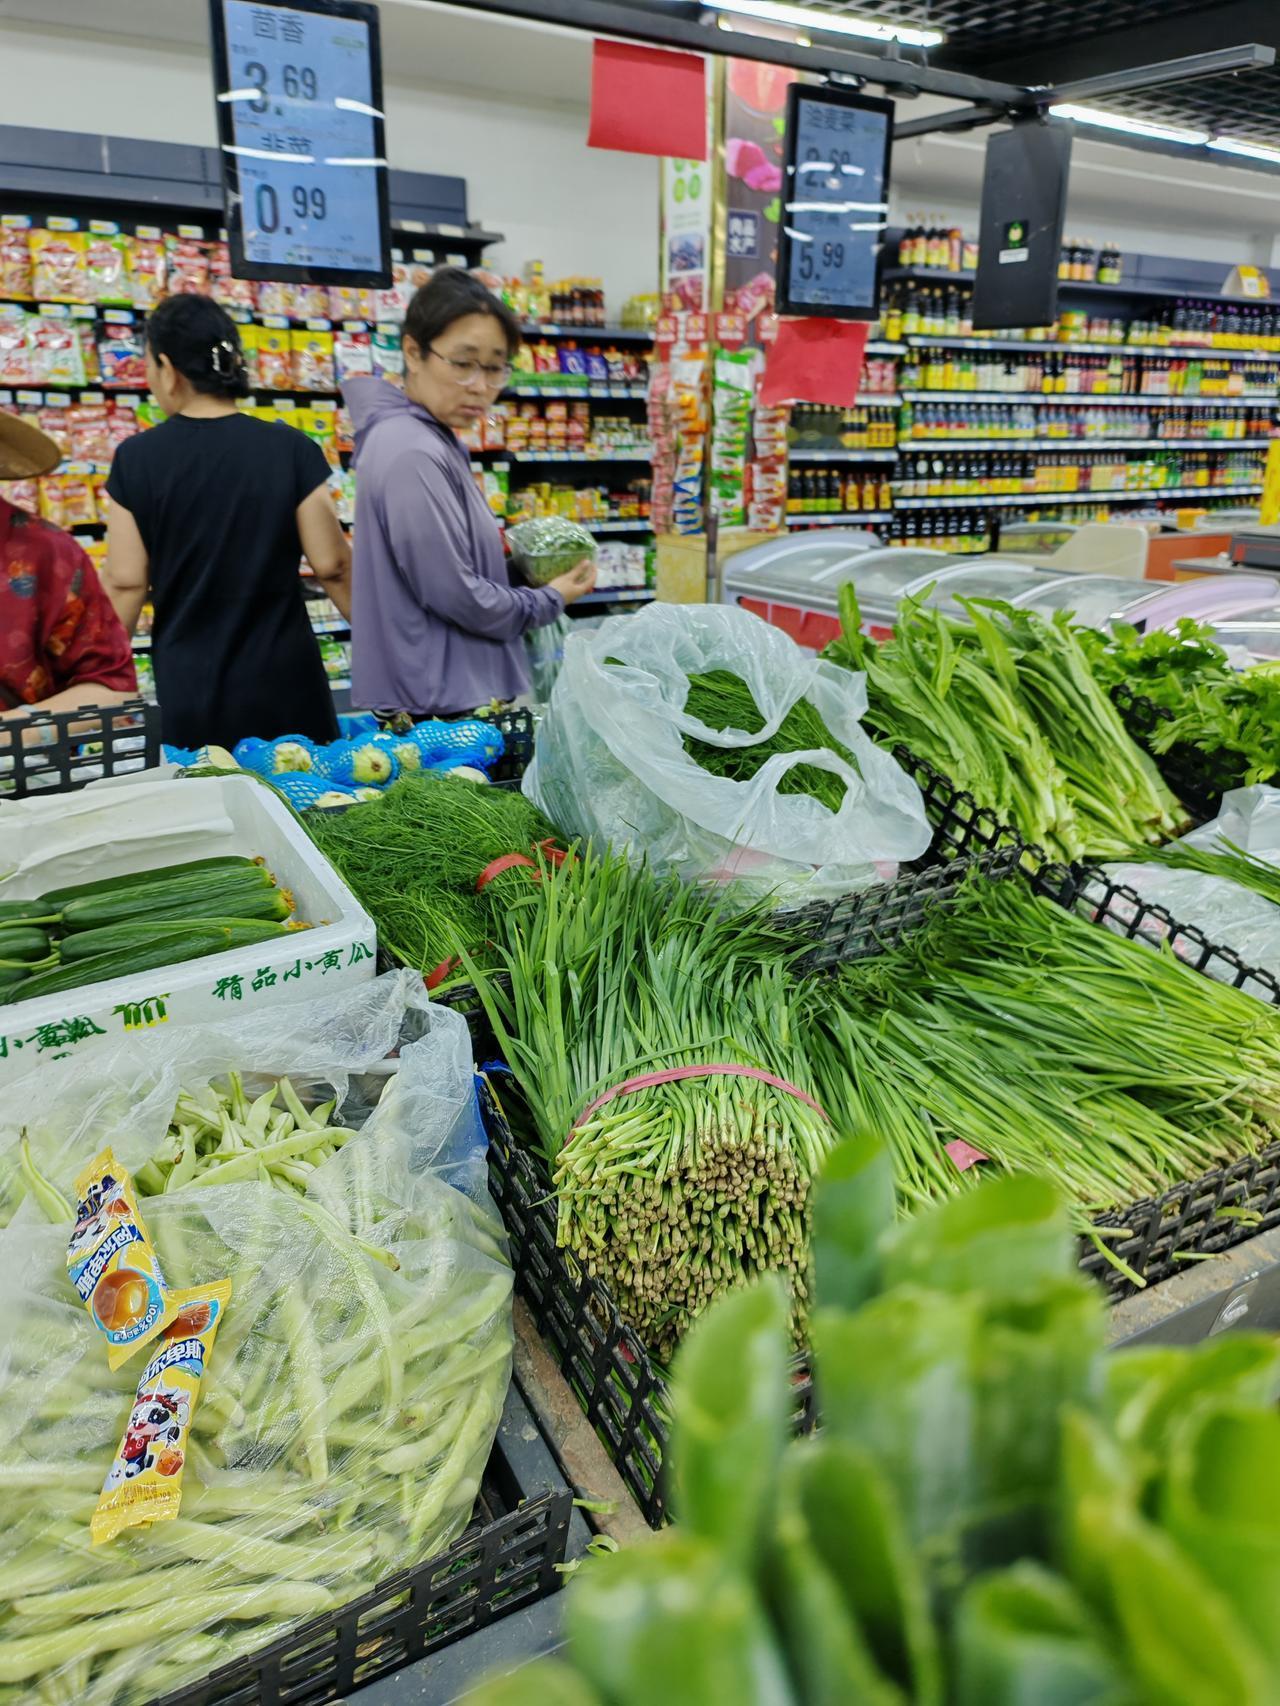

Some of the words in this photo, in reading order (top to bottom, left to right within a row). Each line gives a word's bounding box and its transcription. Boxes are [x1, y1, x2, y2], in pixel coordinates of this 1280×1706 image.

[244, 61, 317, 116] 3.69
[256, 183, 327, 235] 0.99
[798, 241, 844, 281] 5.99
[212, 941, 374, 1001] 精品小黄瓜
